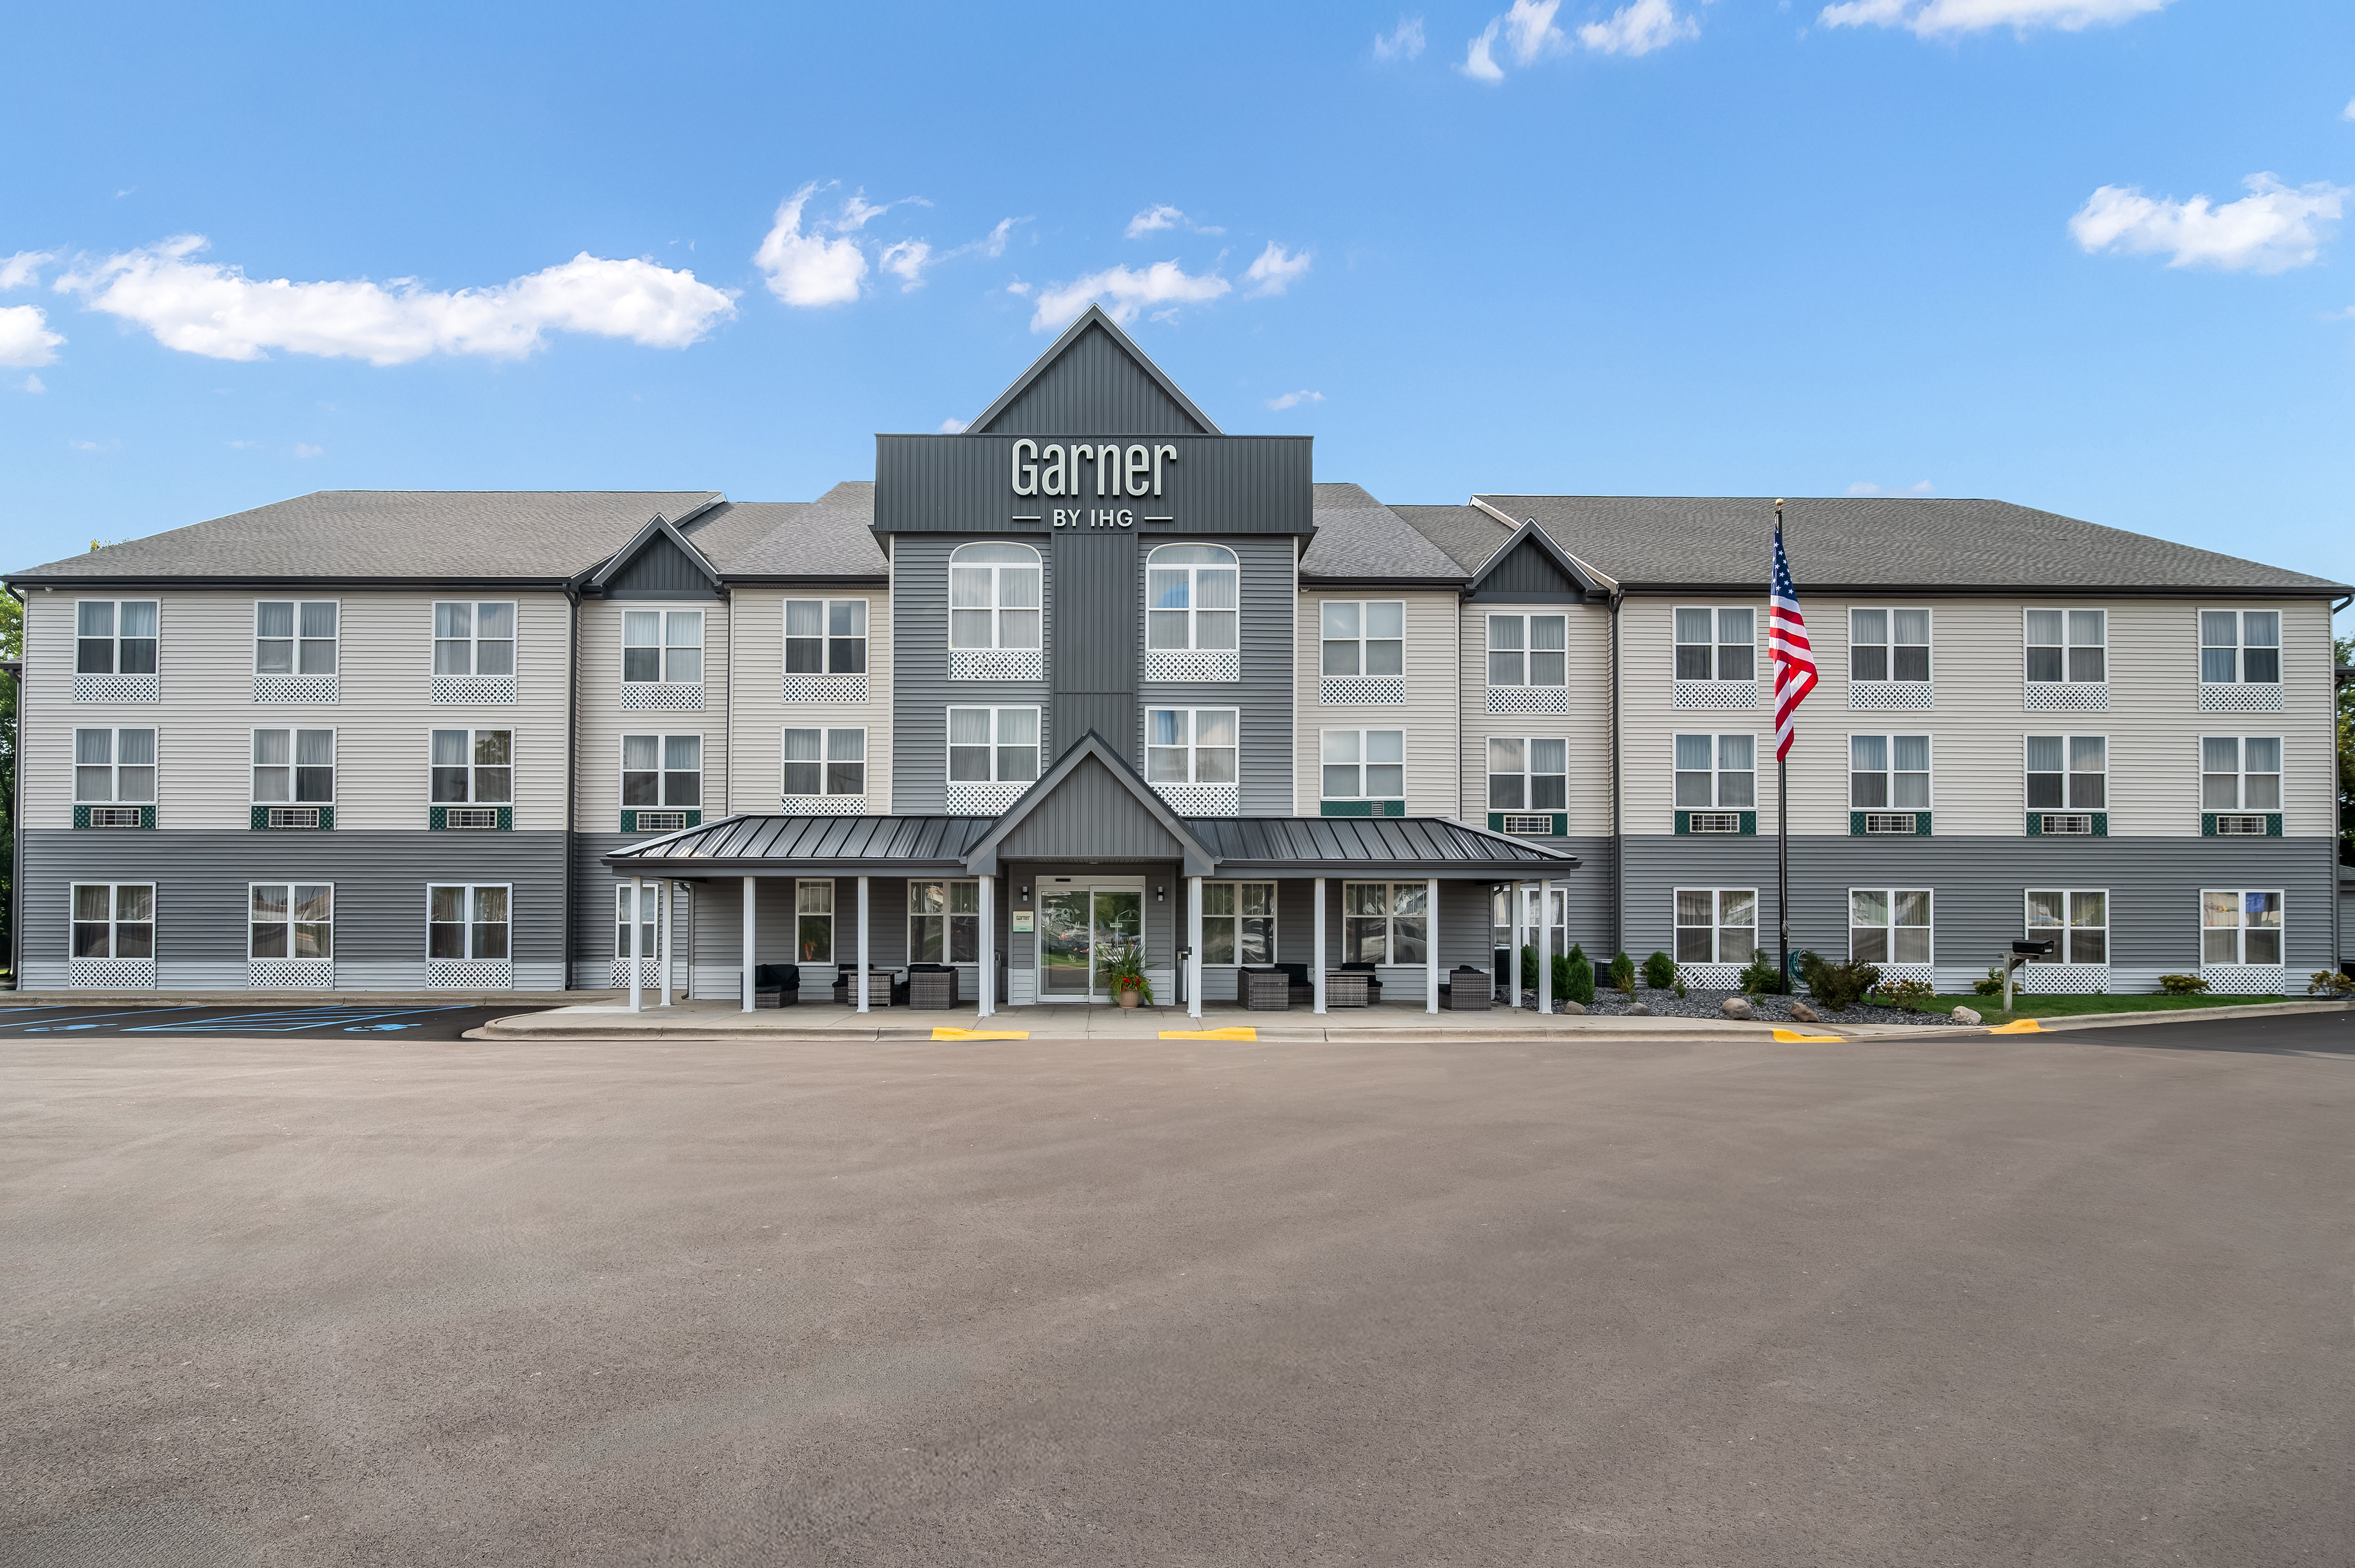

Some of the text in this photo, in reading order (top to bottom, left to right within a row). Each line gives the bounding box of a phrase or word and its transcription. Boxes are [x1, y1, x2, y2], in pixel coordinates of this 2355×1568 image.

[1012, 438, 1177, 497] Garner
[1054, 509, 1133, 527] BY IHG
